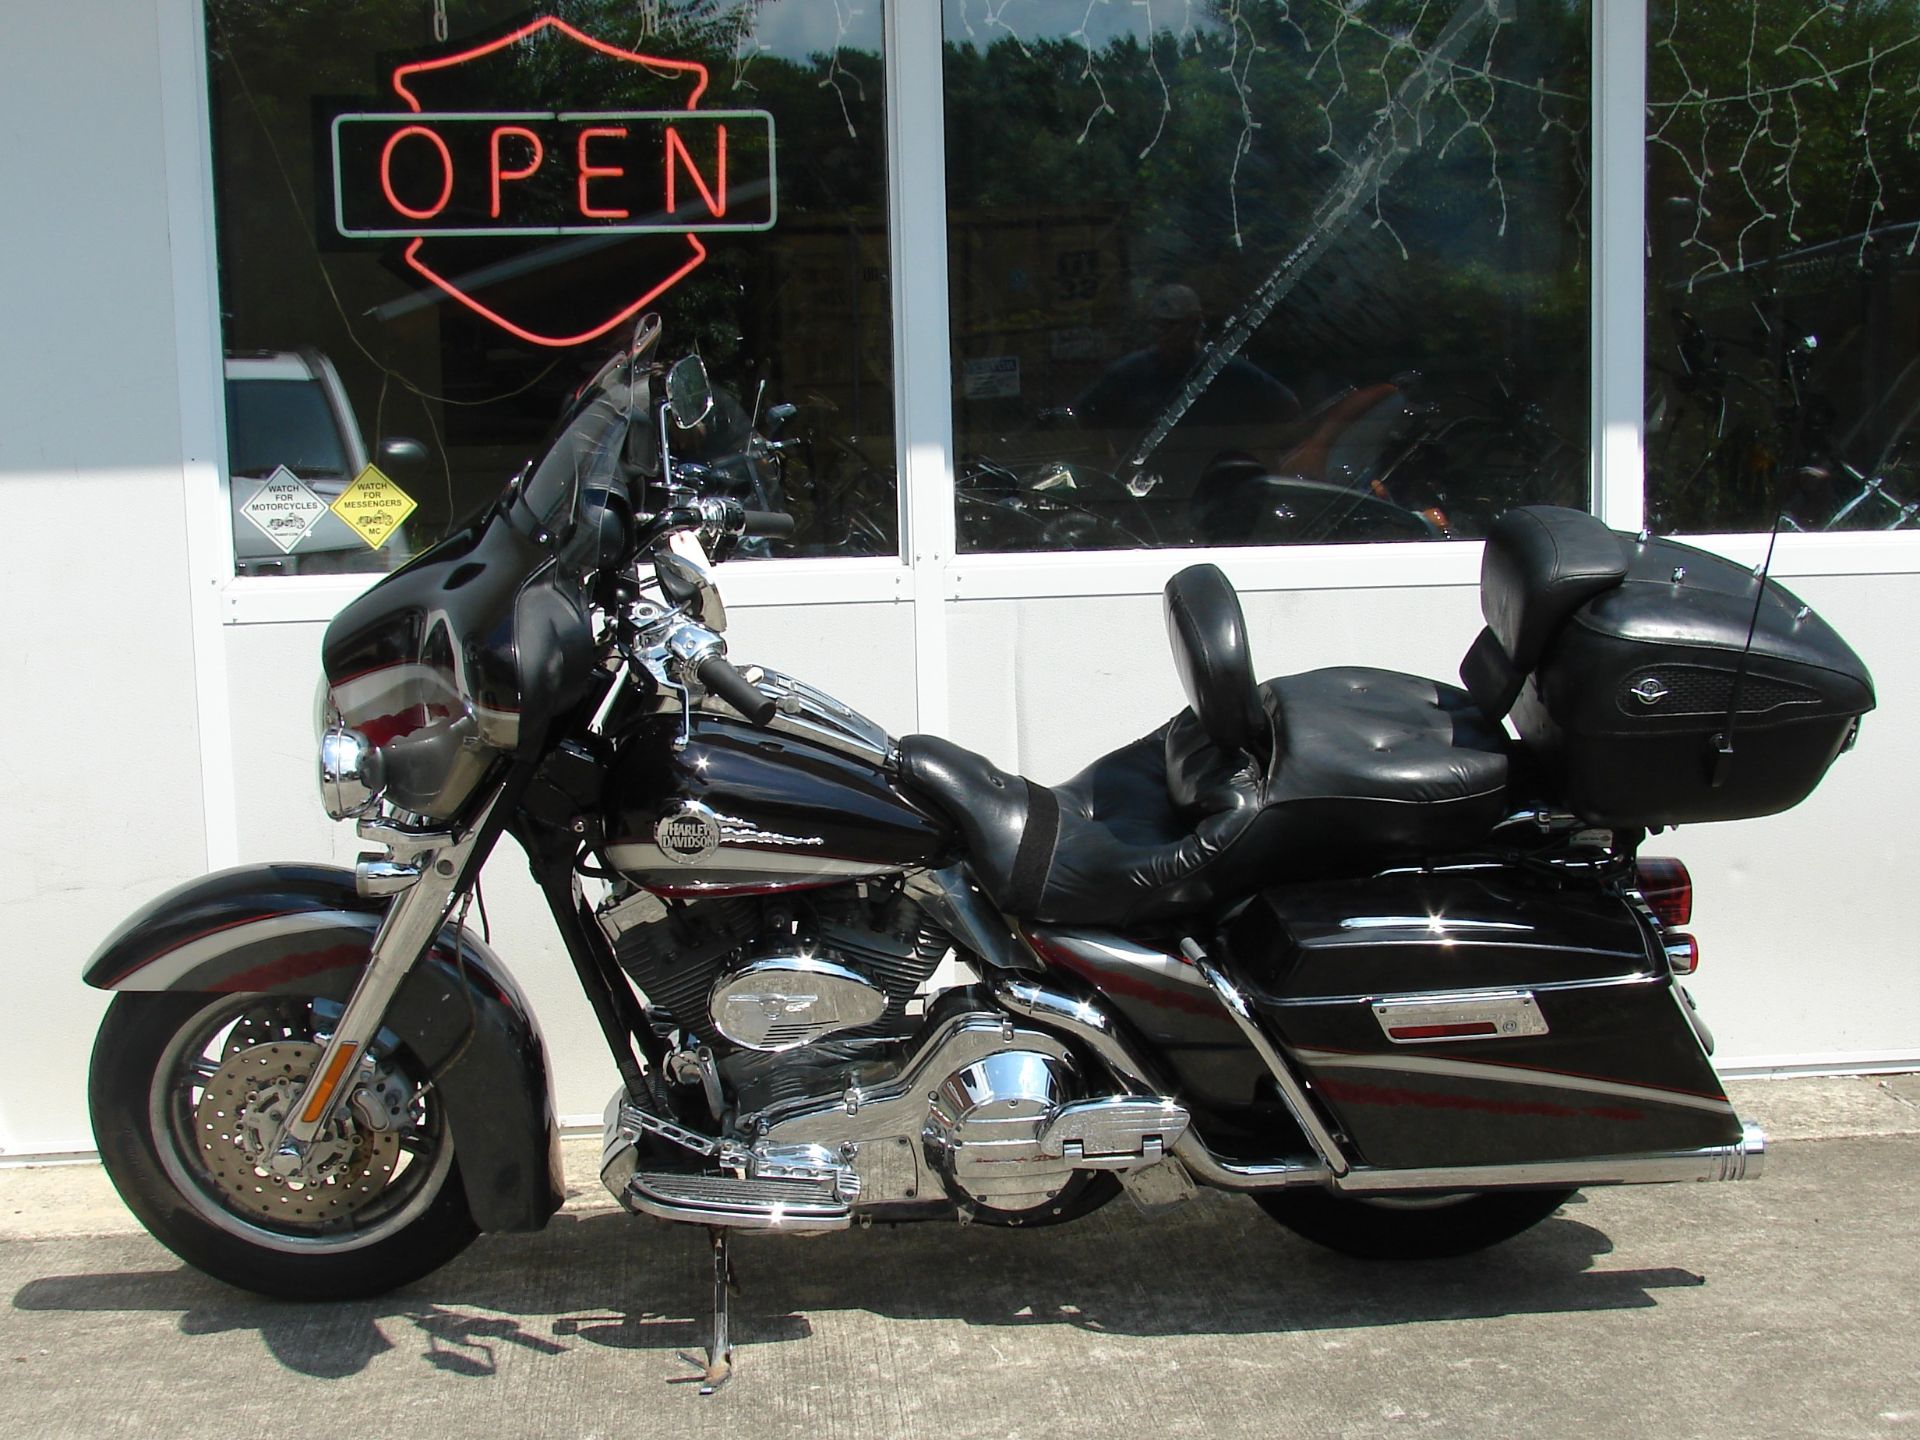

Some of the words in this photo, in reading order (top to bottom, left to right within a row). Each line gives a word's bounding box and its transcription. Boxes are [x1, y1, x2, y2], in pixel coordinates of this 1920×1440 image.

[381, 126, 726, 218] OPEN
[268, 484, 300, 493] WATCH
[357, 482, 388, 490] WATCH
[275, 493, 294, 502] FOR
[363, 491, 381, 499] FOR
[252, 502, 318, 512] MOTORCYCLES
[344, 499, 402, 509] MESSENGERS
[368, 527, 381, 535] MC
[669, 823, 712, 836] HARLEY
[662, 835, 715, 848] DAVIDSON
